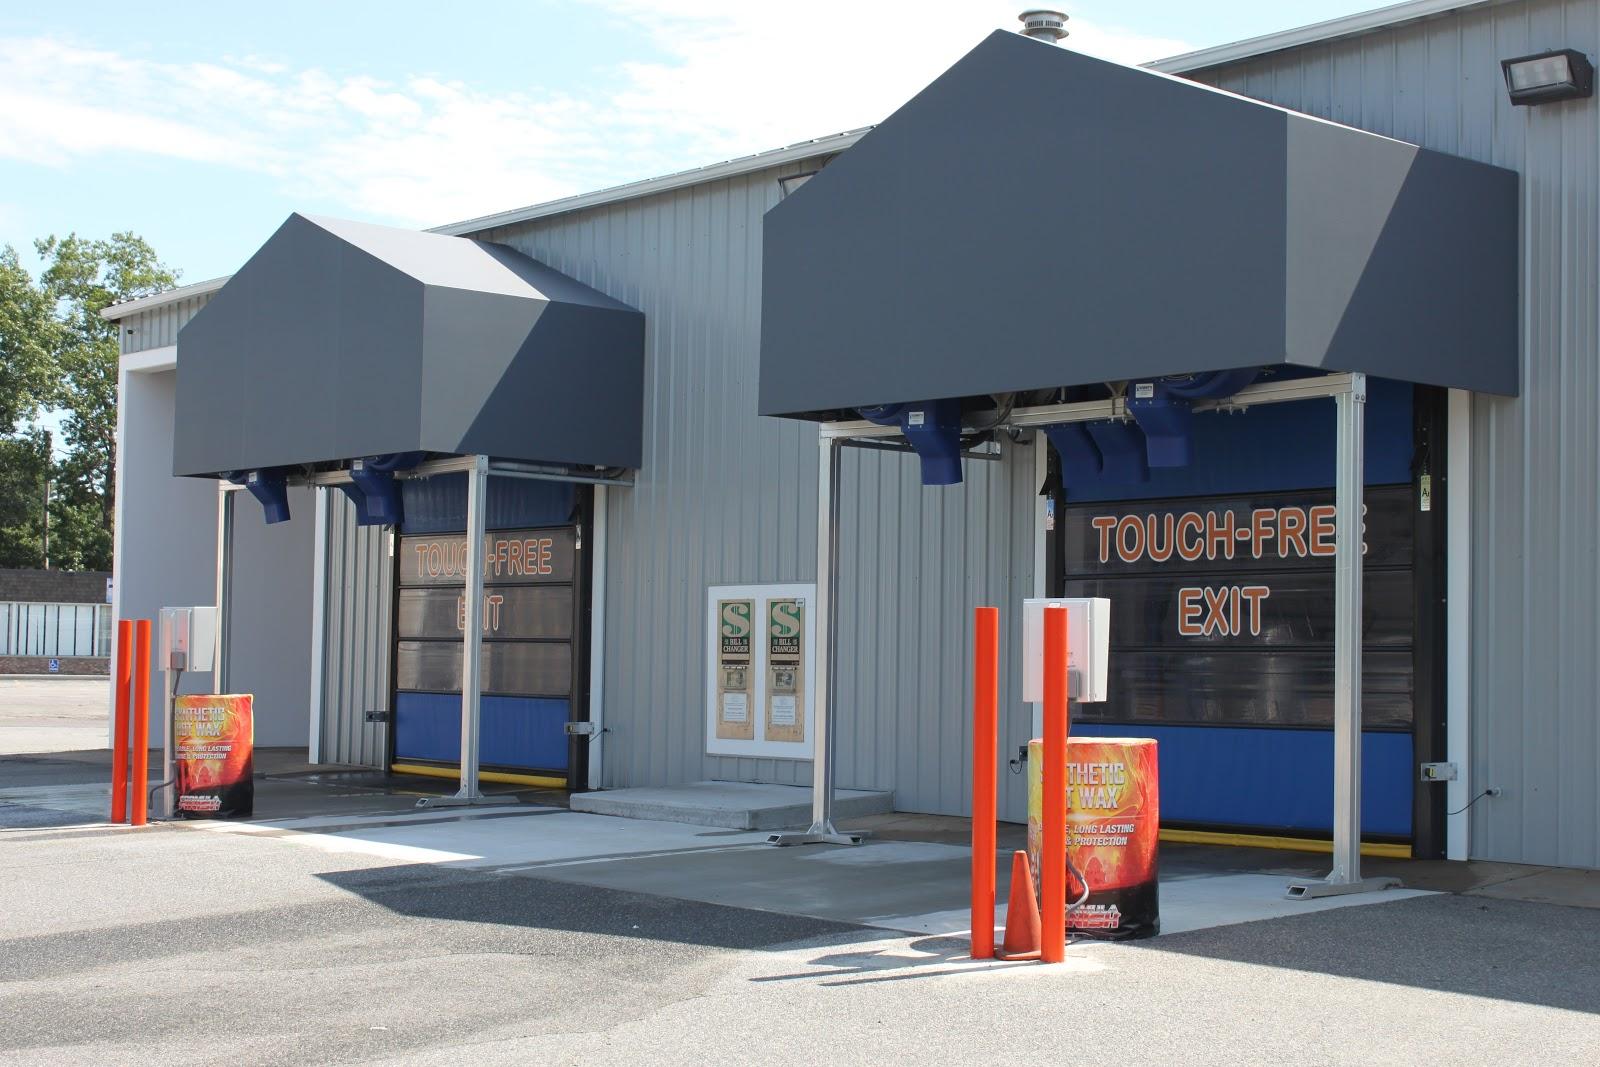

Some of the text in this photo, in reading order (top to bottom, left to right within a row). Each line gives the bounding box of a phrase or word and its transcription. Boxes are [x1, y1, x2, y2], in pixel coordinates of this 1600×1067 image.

[1092, 504, 1367, 563] TOUCH-FRE
[415, 538, 552, 577] TOUC-FREE
[457, 595, 504, 631] EIT
[1178, 586, 1270, 636] EXIT
[723, 645, 749, 653] CHANGER
[772, 645, 799, 653] CHANGER
[196, 721, 222, 736] WAX
[207, 744, 232, 752] LASTING
[192, 752, 227, 760] PROTECTION
[1040, 762, 1125, 785] THETIC
[1080, 787, 1118, 809] WAX
[1074, 824, 1098, 834] LONG
[1099, 823, 1135, 834] LASTING
[1074, 836, 1128, 847] PROTECTION
